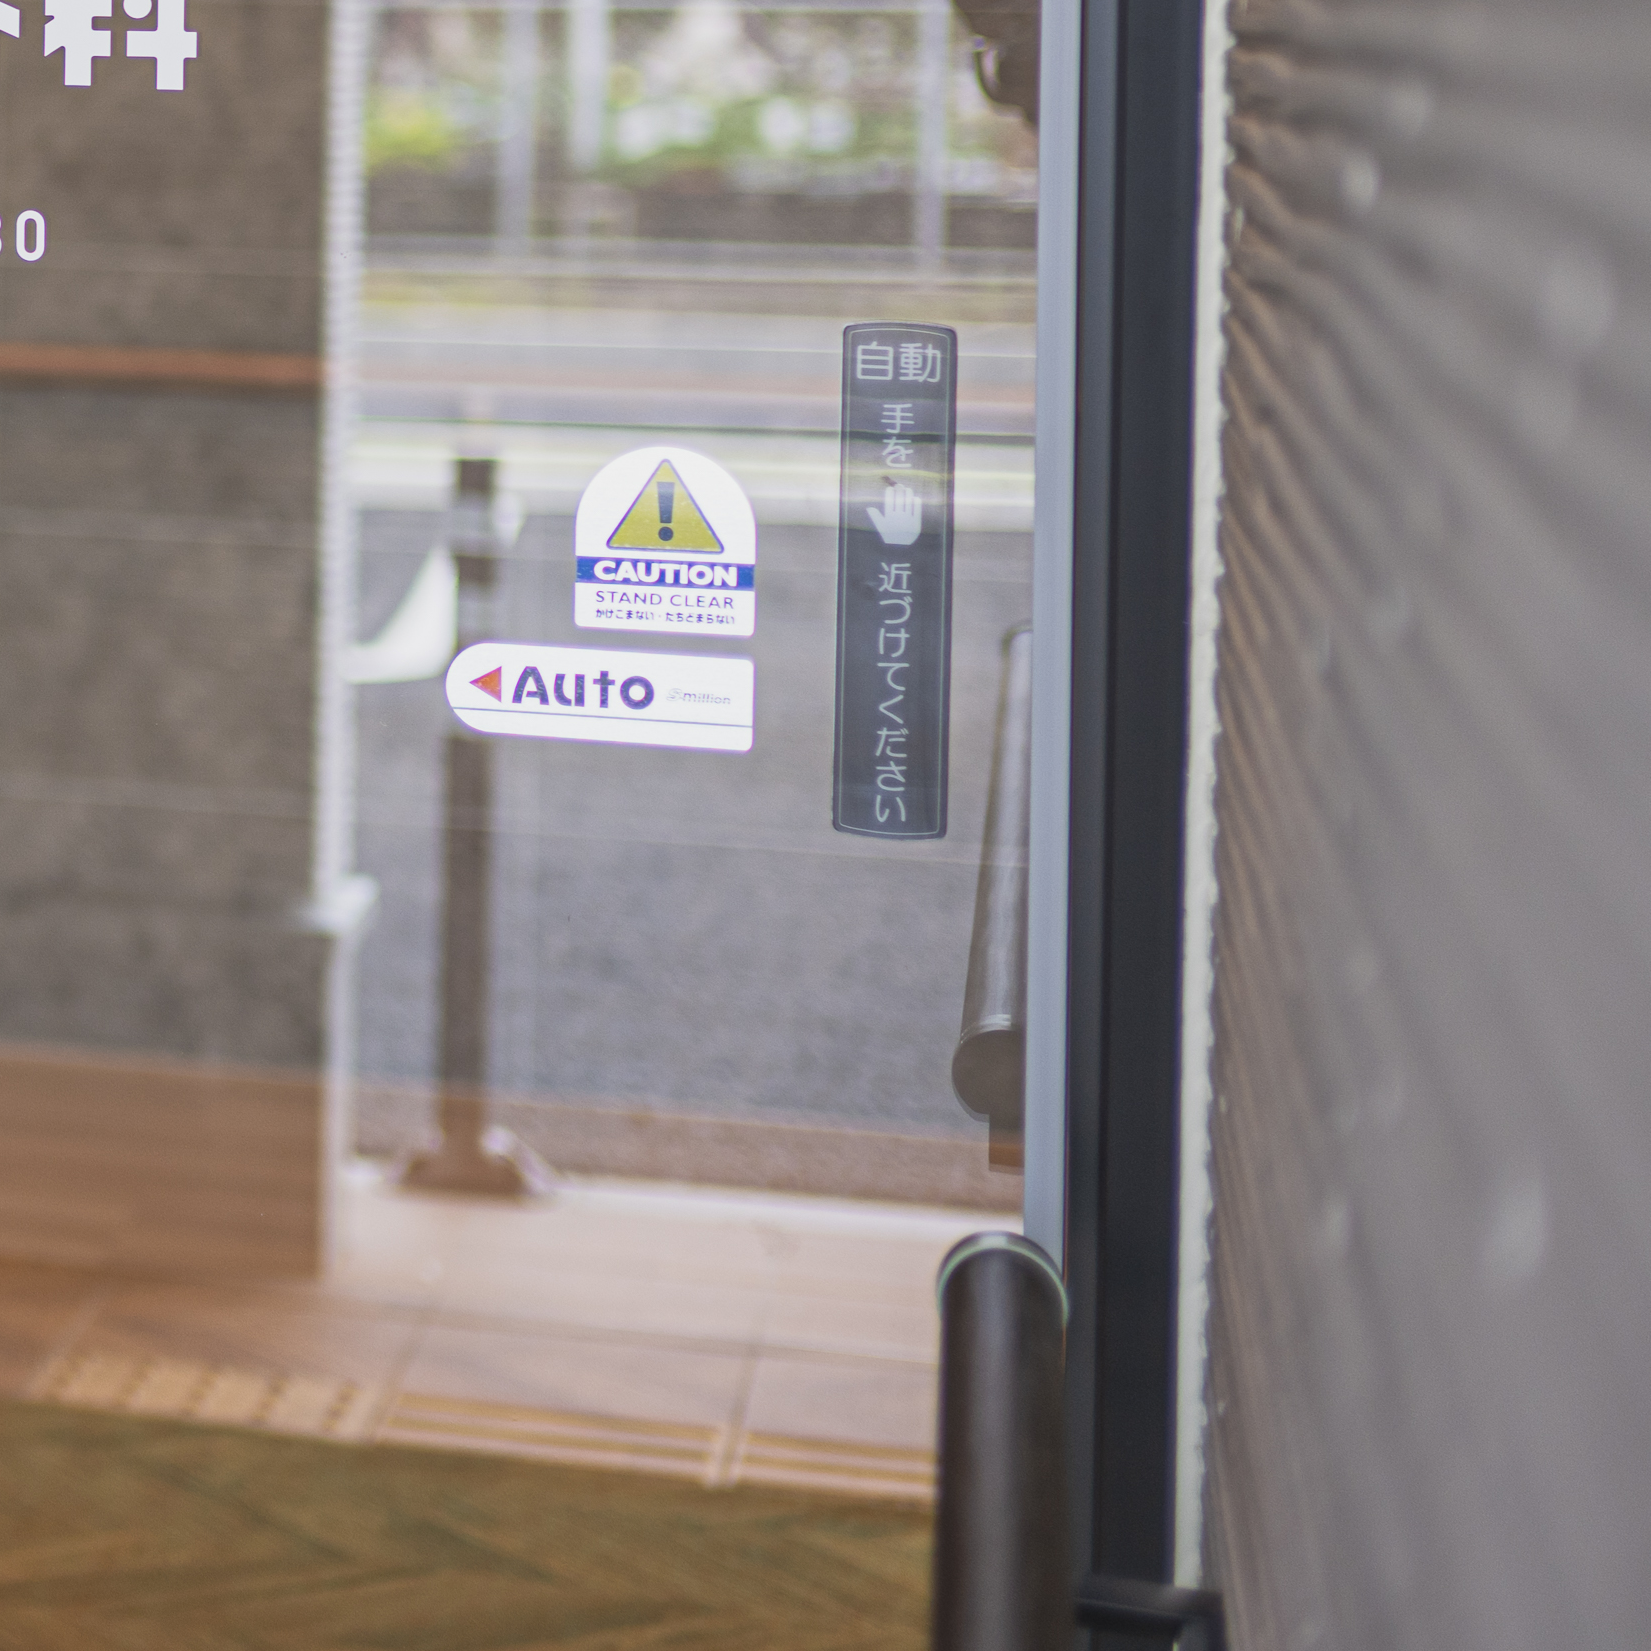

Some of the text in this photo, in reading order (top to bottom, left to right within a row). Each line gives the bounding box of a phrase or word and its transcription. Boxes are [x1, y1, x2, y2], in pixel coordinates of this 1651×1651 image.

[856, 341, 942, 383] 自動
[880, 403, 915, 468] 手を
[593, 560, 738, 587] CAUTION
[596, 590, 734, 609] STAND CLEAR
[512, 665, 655, 710] Auto
[875, 562, 913, 823] 近づけてください
